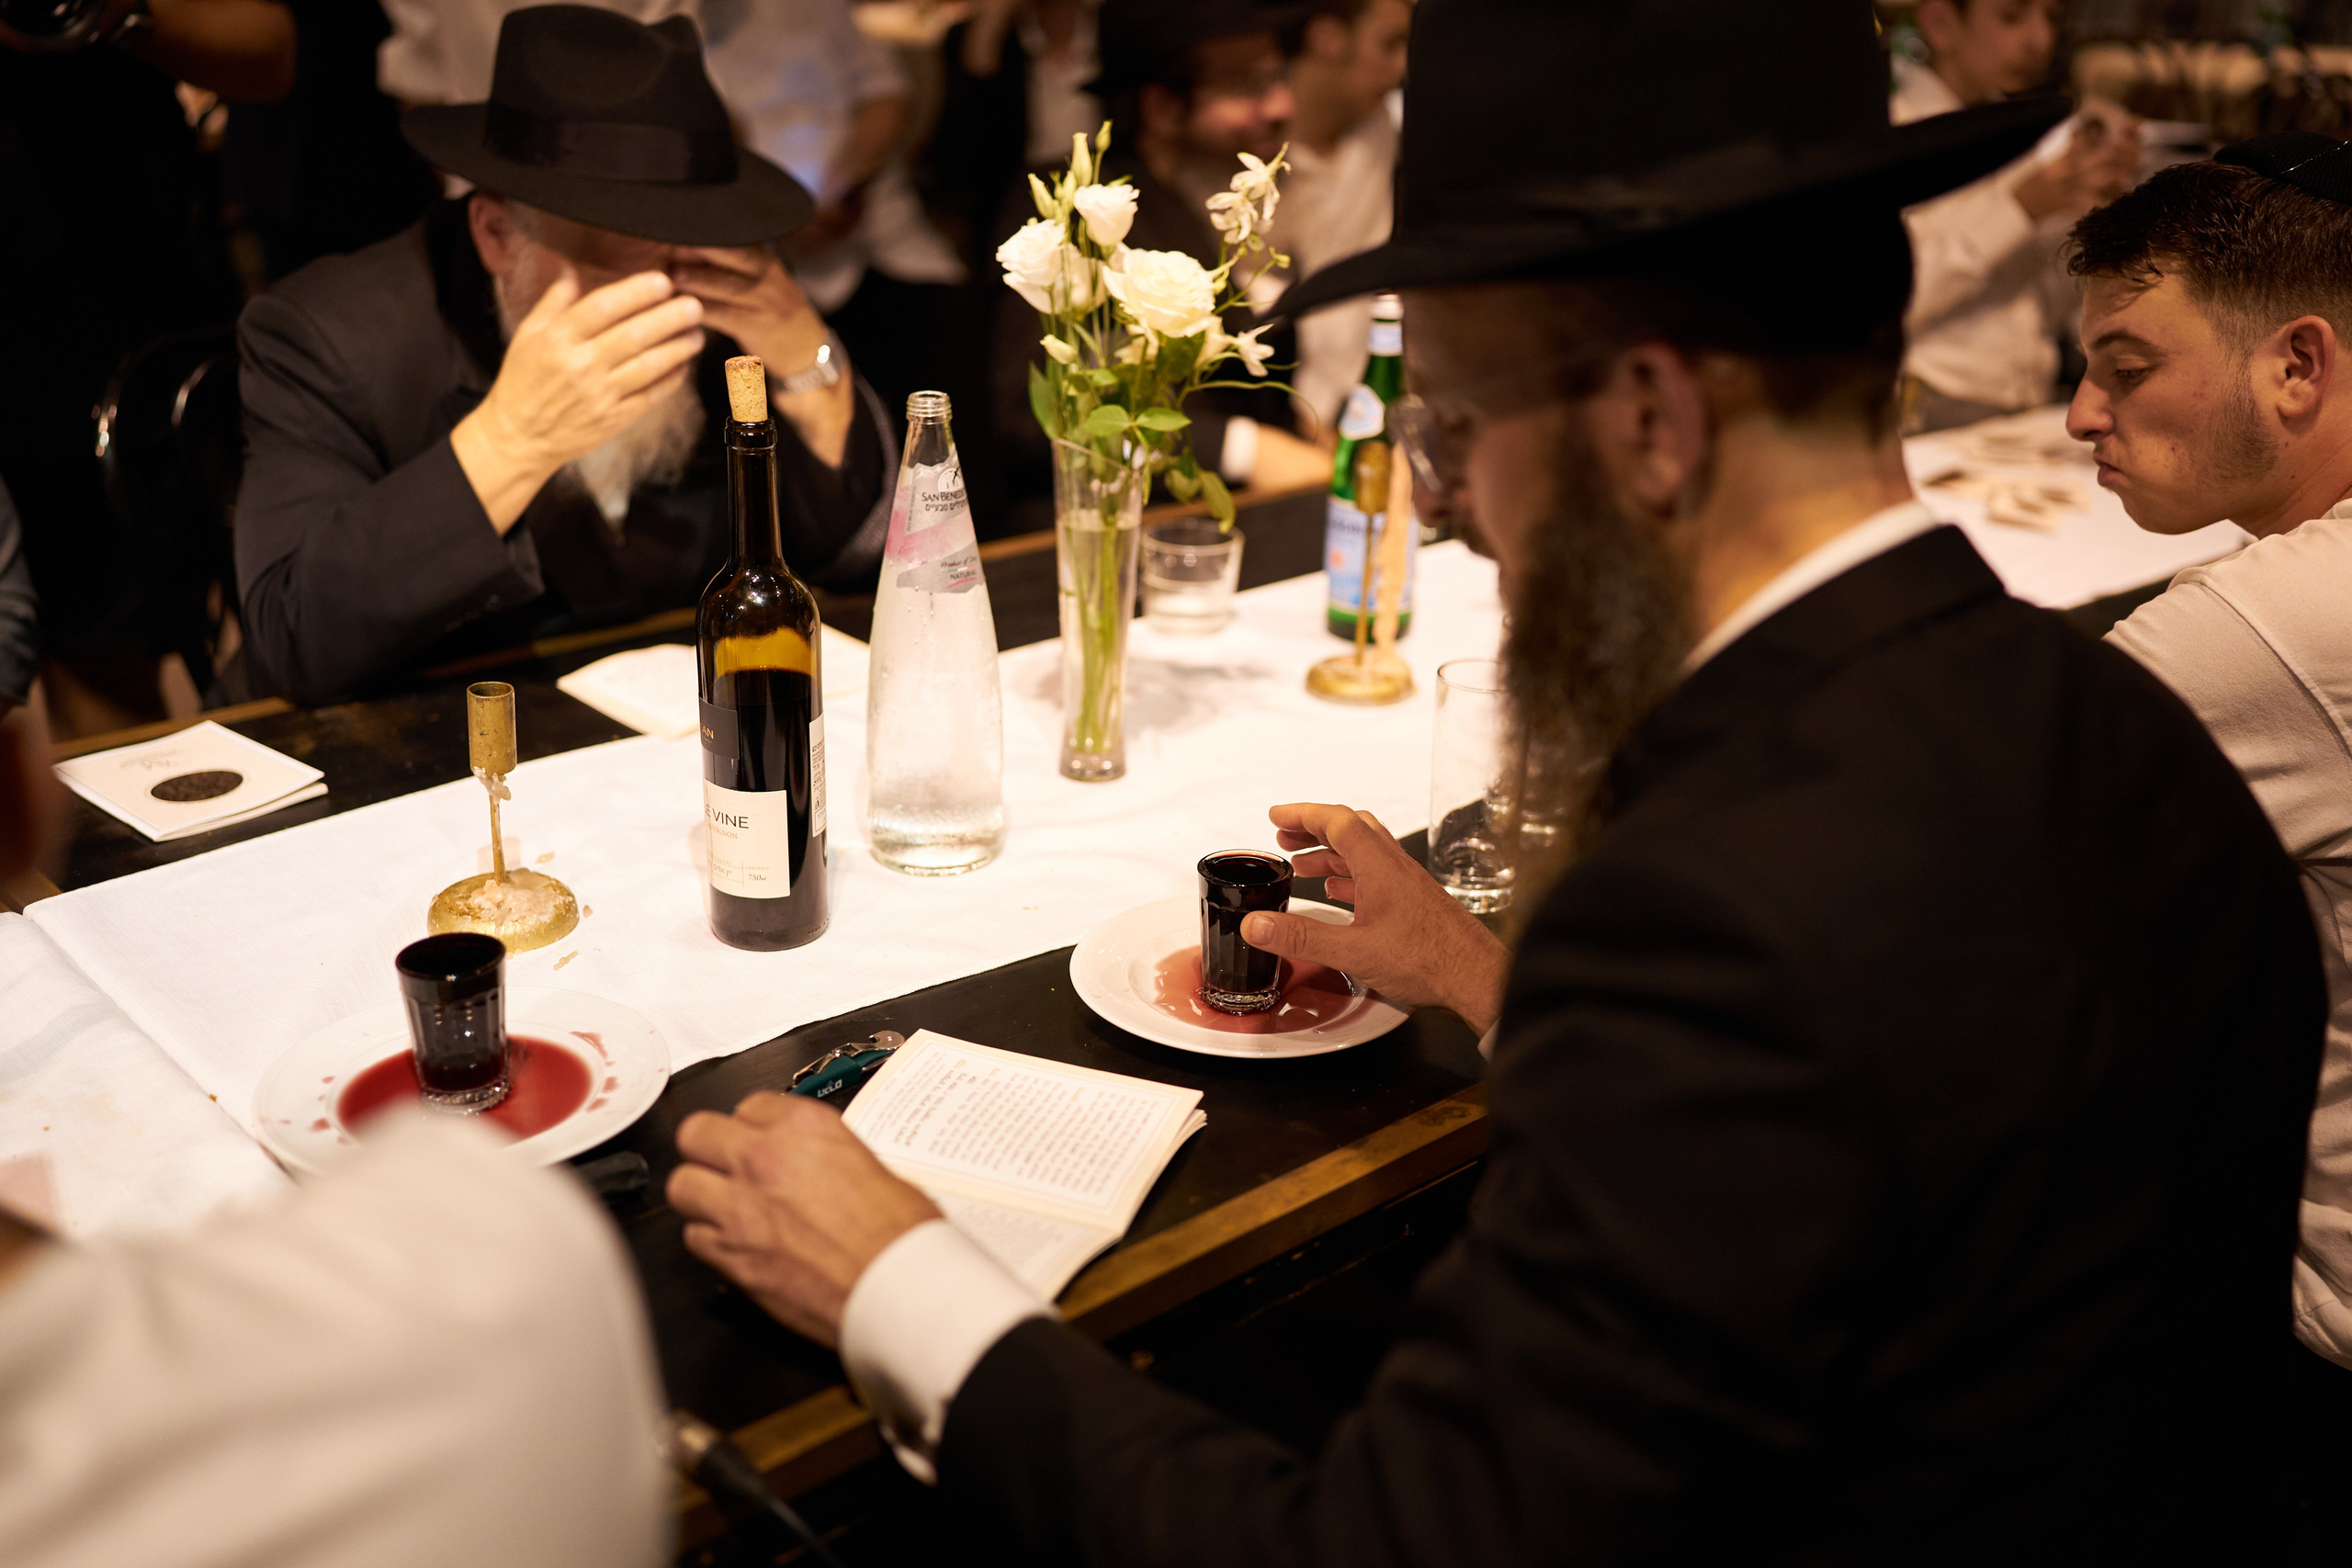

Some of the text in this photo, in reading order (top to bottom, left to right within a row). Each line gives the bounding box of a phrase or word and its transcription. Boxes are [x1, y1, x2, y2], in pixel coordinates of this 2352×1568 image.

[922, 491, 939, 502] SAN
[712, 807, 749, 829] VINE
[748, 874, 767, 882] 750ml
